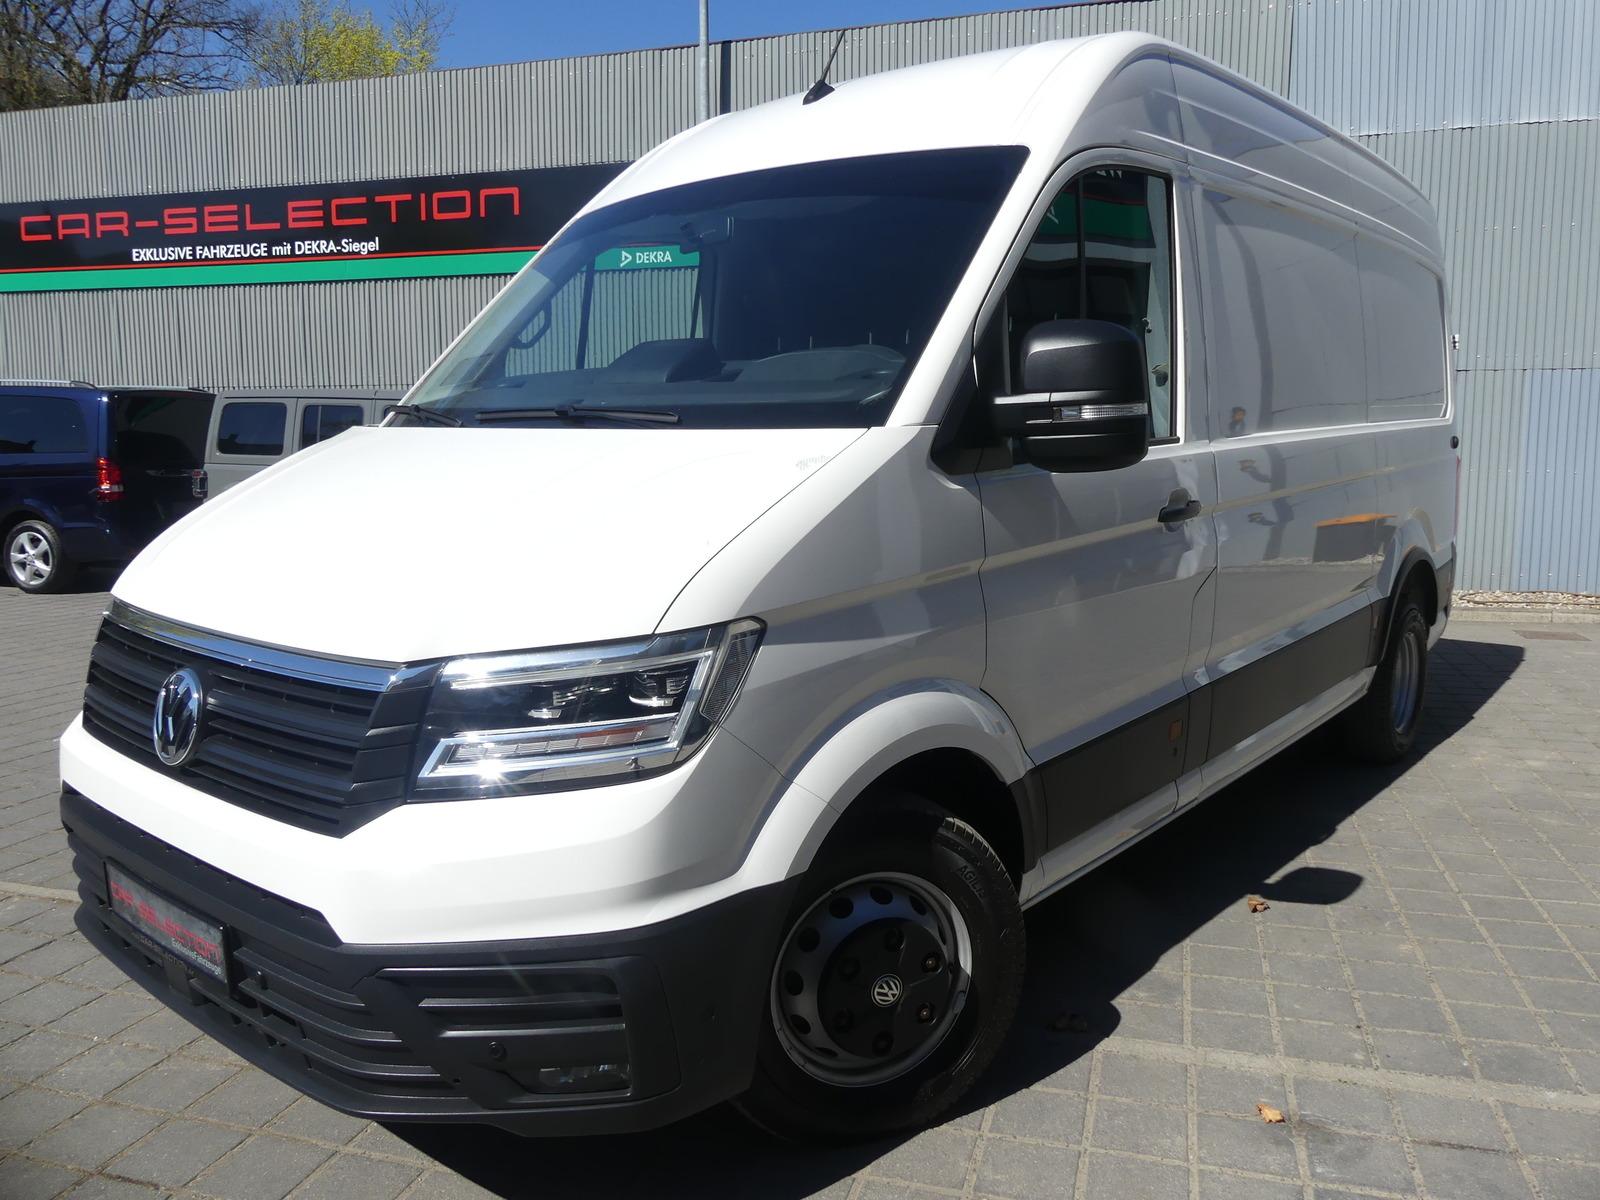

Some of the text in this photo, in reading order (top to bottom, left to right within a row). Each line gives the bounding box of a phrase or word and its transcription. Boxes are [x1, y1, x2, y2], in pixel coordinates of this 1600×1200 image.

[20, 185, 520, 243] CAR-SELECTION
[131, 236, 380, 262] EXKLUSIVE FAHRZEUGE mit DEKRA-Siegel
[636, 250, 672, 264] DEKRA
